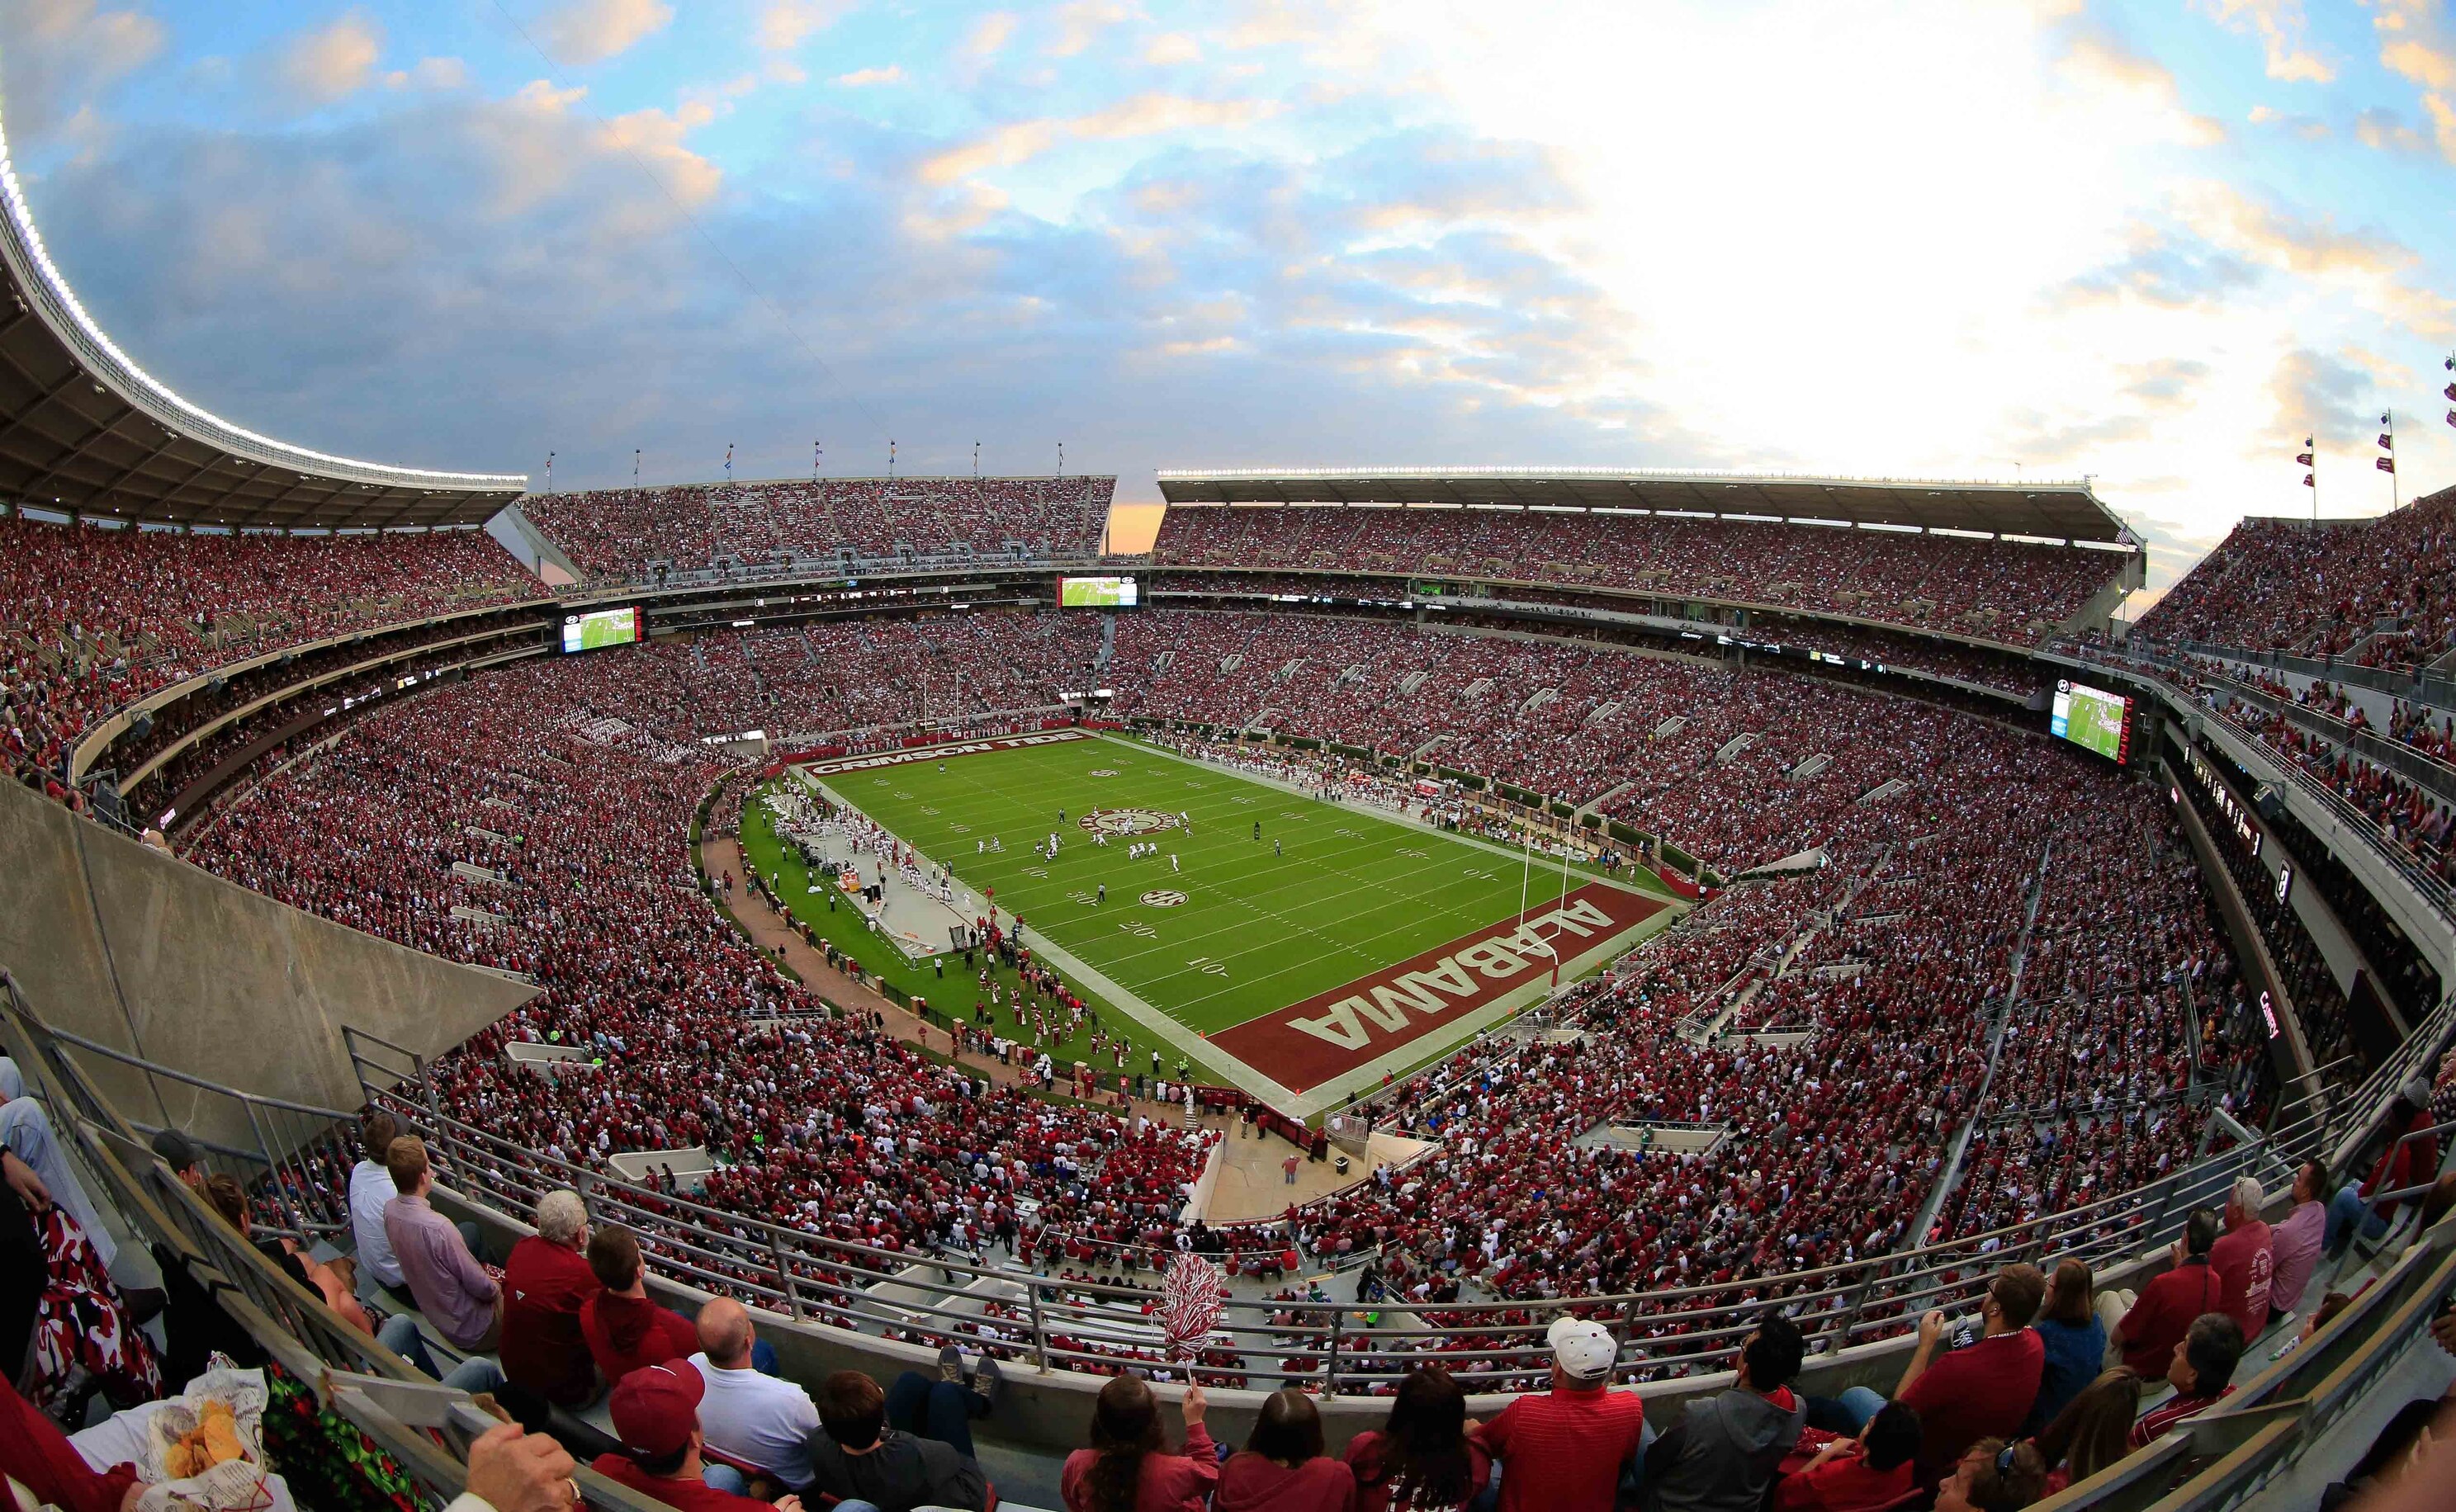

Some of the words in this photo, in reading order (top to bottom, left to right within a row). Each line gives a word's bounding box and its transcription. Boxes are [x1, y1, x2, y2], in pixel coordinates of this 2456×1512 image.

[963, 725, 1011, 739] CRIMSON
[1018, 721, 1043, 733] TDE
[2118, 695, 2136, 766] ALABAMA
[813, 743, 993, 774] CRIMSON
[997, 732, 1083, 747] TIDE
[845, 739, 903, 755] ALABMA
[1066, 890, 1097, 906] 30
[1119, 921, 1156, 938] 20
[1185, 957, 1226, 975] 10
[1285, 898, 1616, 1051] ALABAMA
[1072, 1363, 1082, 1372] 12
